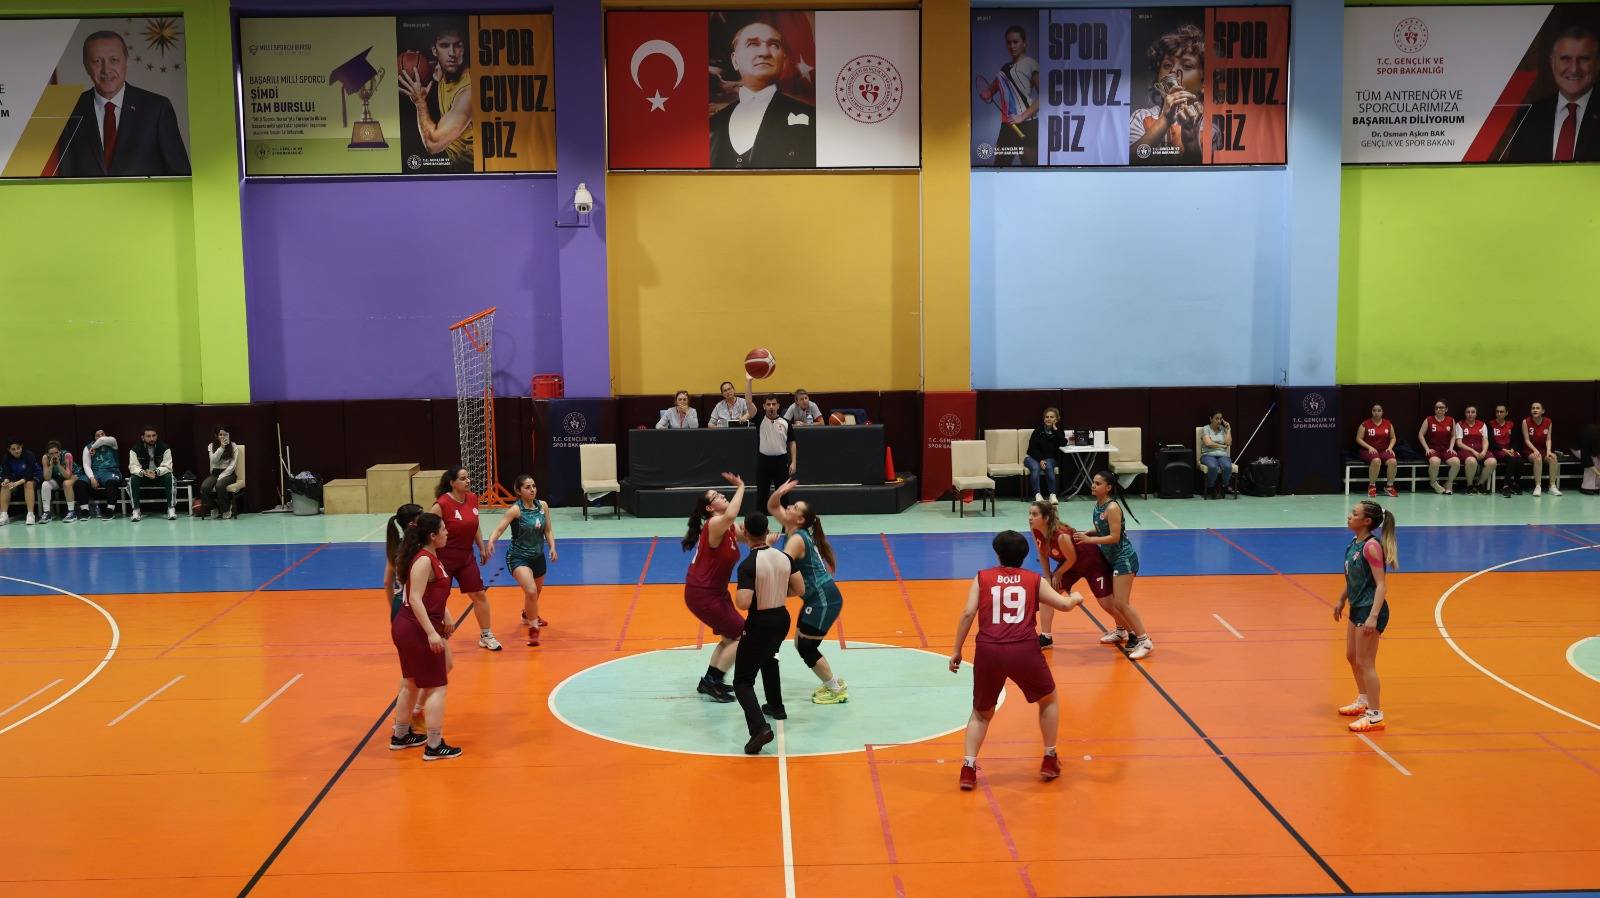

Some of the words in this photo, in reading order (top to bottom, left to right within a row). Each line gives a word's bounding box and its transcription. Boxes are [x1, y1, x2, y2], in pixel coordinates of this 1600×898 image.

[1048, 22, 1108, 60] SPOR
[1214, 21, 1268, 59] SPOR
[479, 28, 534, 66] SPOR
[1394, 57, 1430, 67] GENÇLİK
[1376, 67, 1398, 75] SPOR
[1400, 66, 1444, 74] BAKANLIĞI
[300, 74, 326, 84] SPORCU
[251, 86, 279, 102] ŞİMDİ
[1356, 90, 1382, 102] TÜM
[1384, 88, 1447, 101] ANTRENÖR
[1449, 90, 1463, 100] VE
[251, 102, 271, 113] TAM
[274, 101, 316, 113] BURSLU!
[1358, 102, 1459, 114] SPORCULARIMIZA
[1352, 116, 1408, 126] BAŞARILAR
[1410, 114, 1465, 124] DİLİYORUM
[1048, 111, 1086, 152] BİZ
[1212, 110, 1246, 151] BİZ
[1409, 130, 1429, 138] Aşkın
[481, 116, 517, 158] BİZ
[1361, 140, 1394, 148] GENÇLİK
[1432, 424, 1437, 432] 5
[1494, 428, 1501, 436] 12
[1530, 428, 1534, 436] 3
[454, 510, 462, 520] 4
[996, 574, 1021, 584] BOLU
[990, 585, 1026, 624] 19
